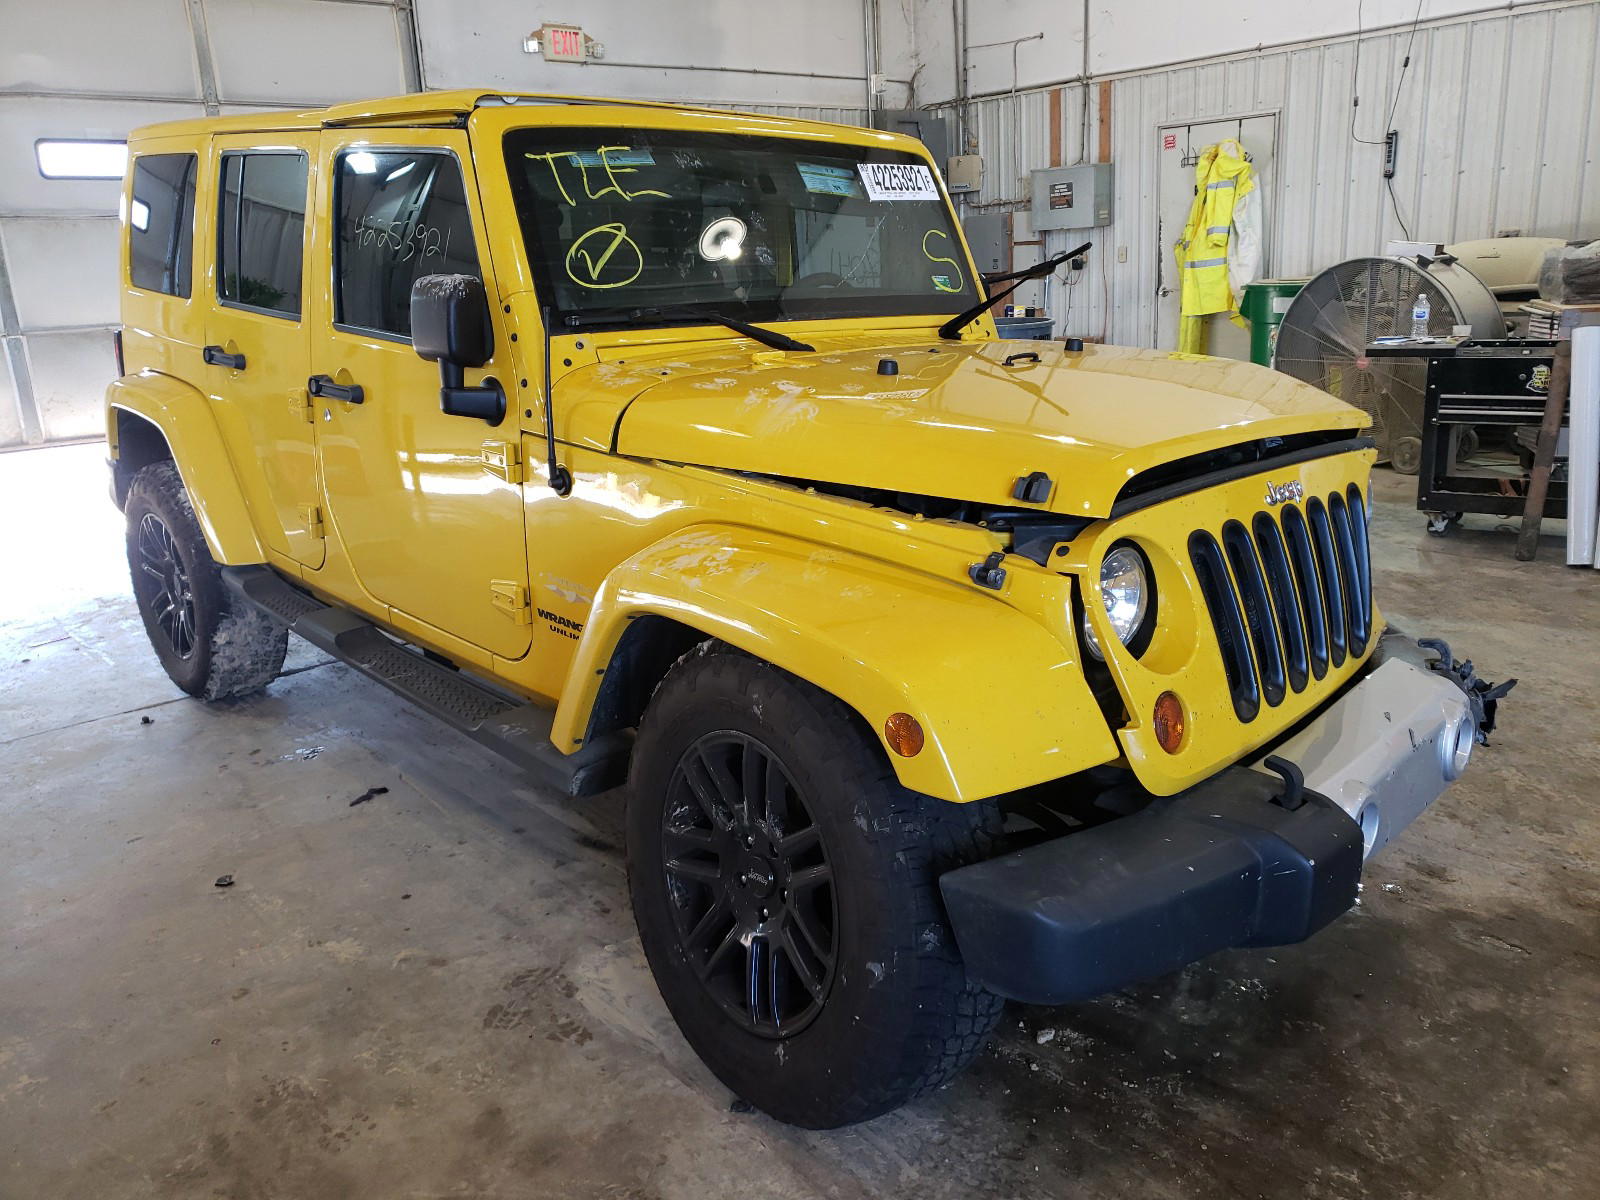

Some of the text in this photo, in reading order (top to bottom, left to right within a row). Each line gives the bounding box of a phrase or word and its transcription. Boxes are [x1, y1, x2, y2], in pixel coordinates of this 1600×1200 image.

[551, 29, 580, 57] EXIT
[871, 164, 929, 192] 42253921
[354, 215, 452, 266] 42253921
[1265, 480, 1303, 506] Jeep
[537, 607, 584, 633] WRANG
